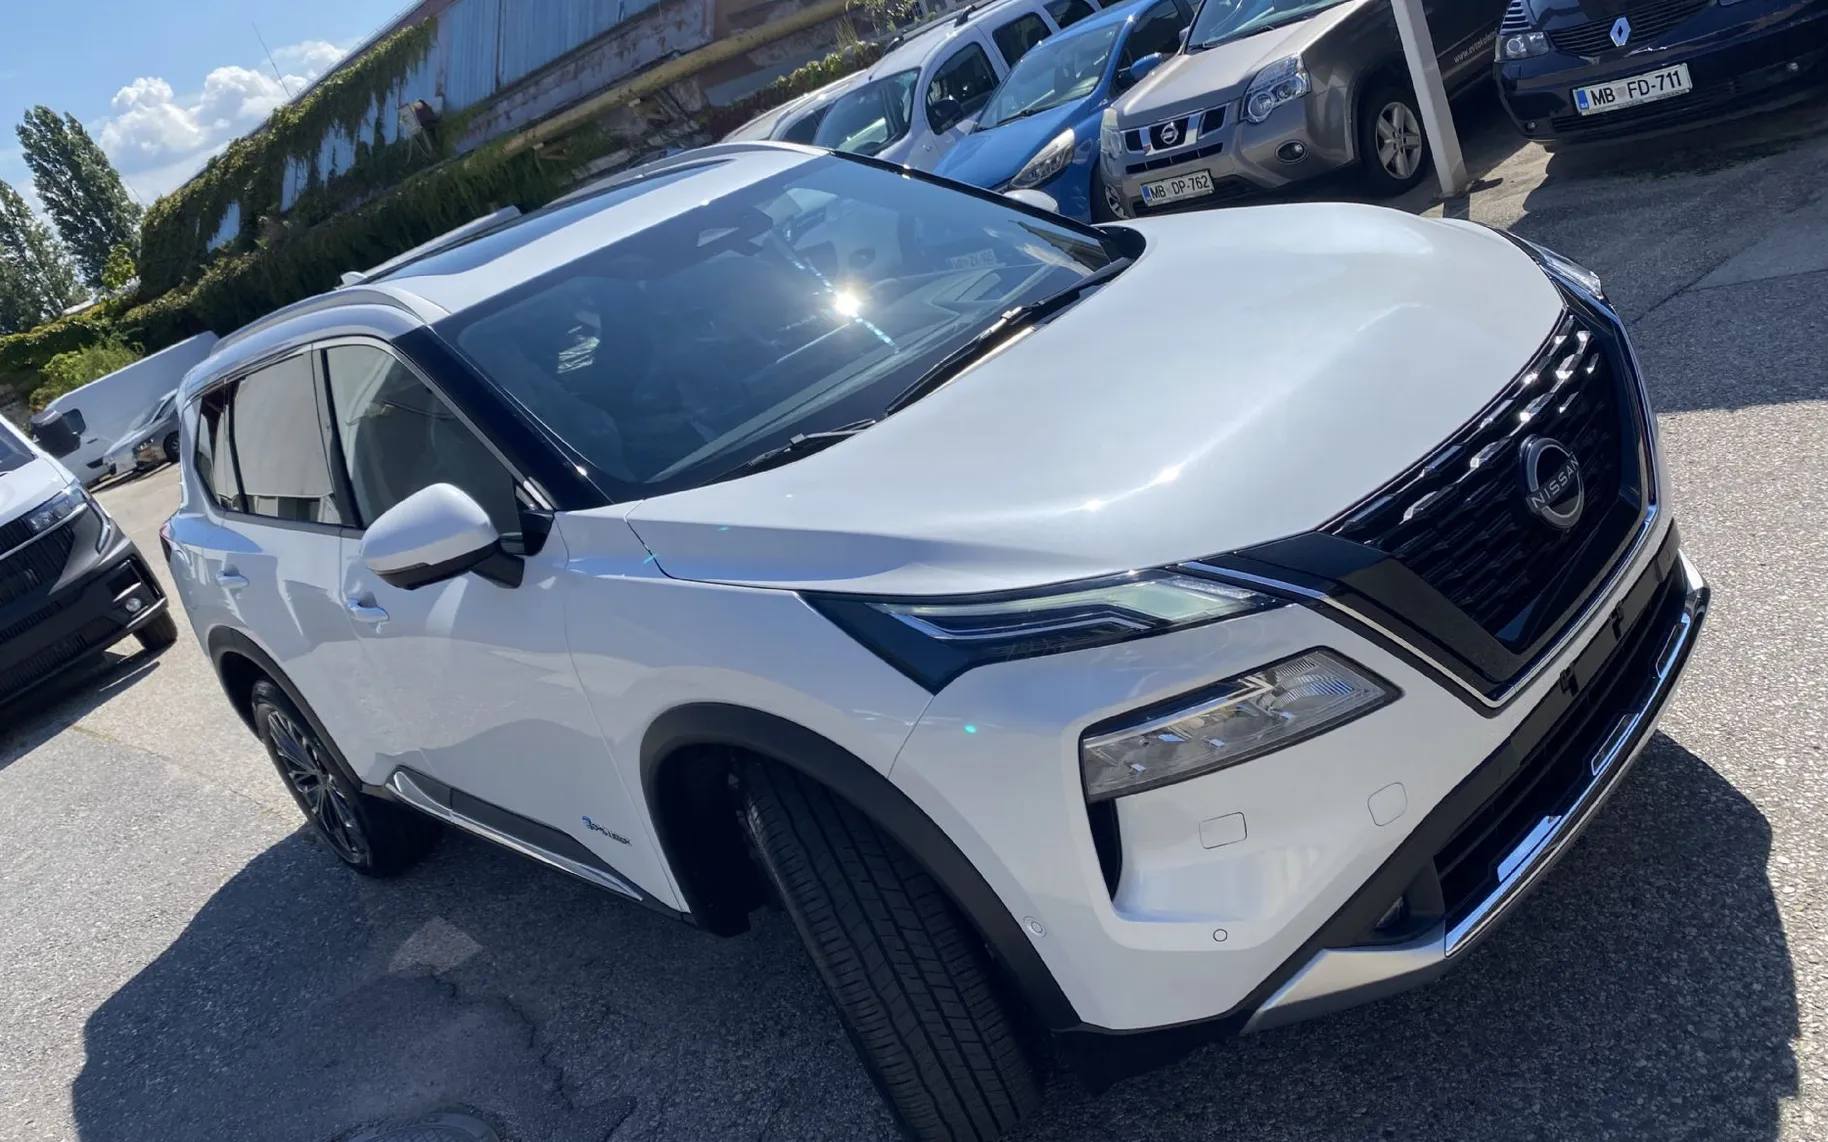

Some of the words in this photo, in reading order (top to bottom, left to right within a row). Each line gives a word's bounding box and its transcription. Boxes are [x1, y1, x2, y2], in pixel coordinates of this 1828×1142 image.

[1590, 87, 1615, 106] MB
[1627, 70, 1682, 99] FD-711
[1149, 185, 1167, 200] MB
[1171, 175, 1210, 195] DP-762
[1530, 453, 1580, 509] NISSAN
